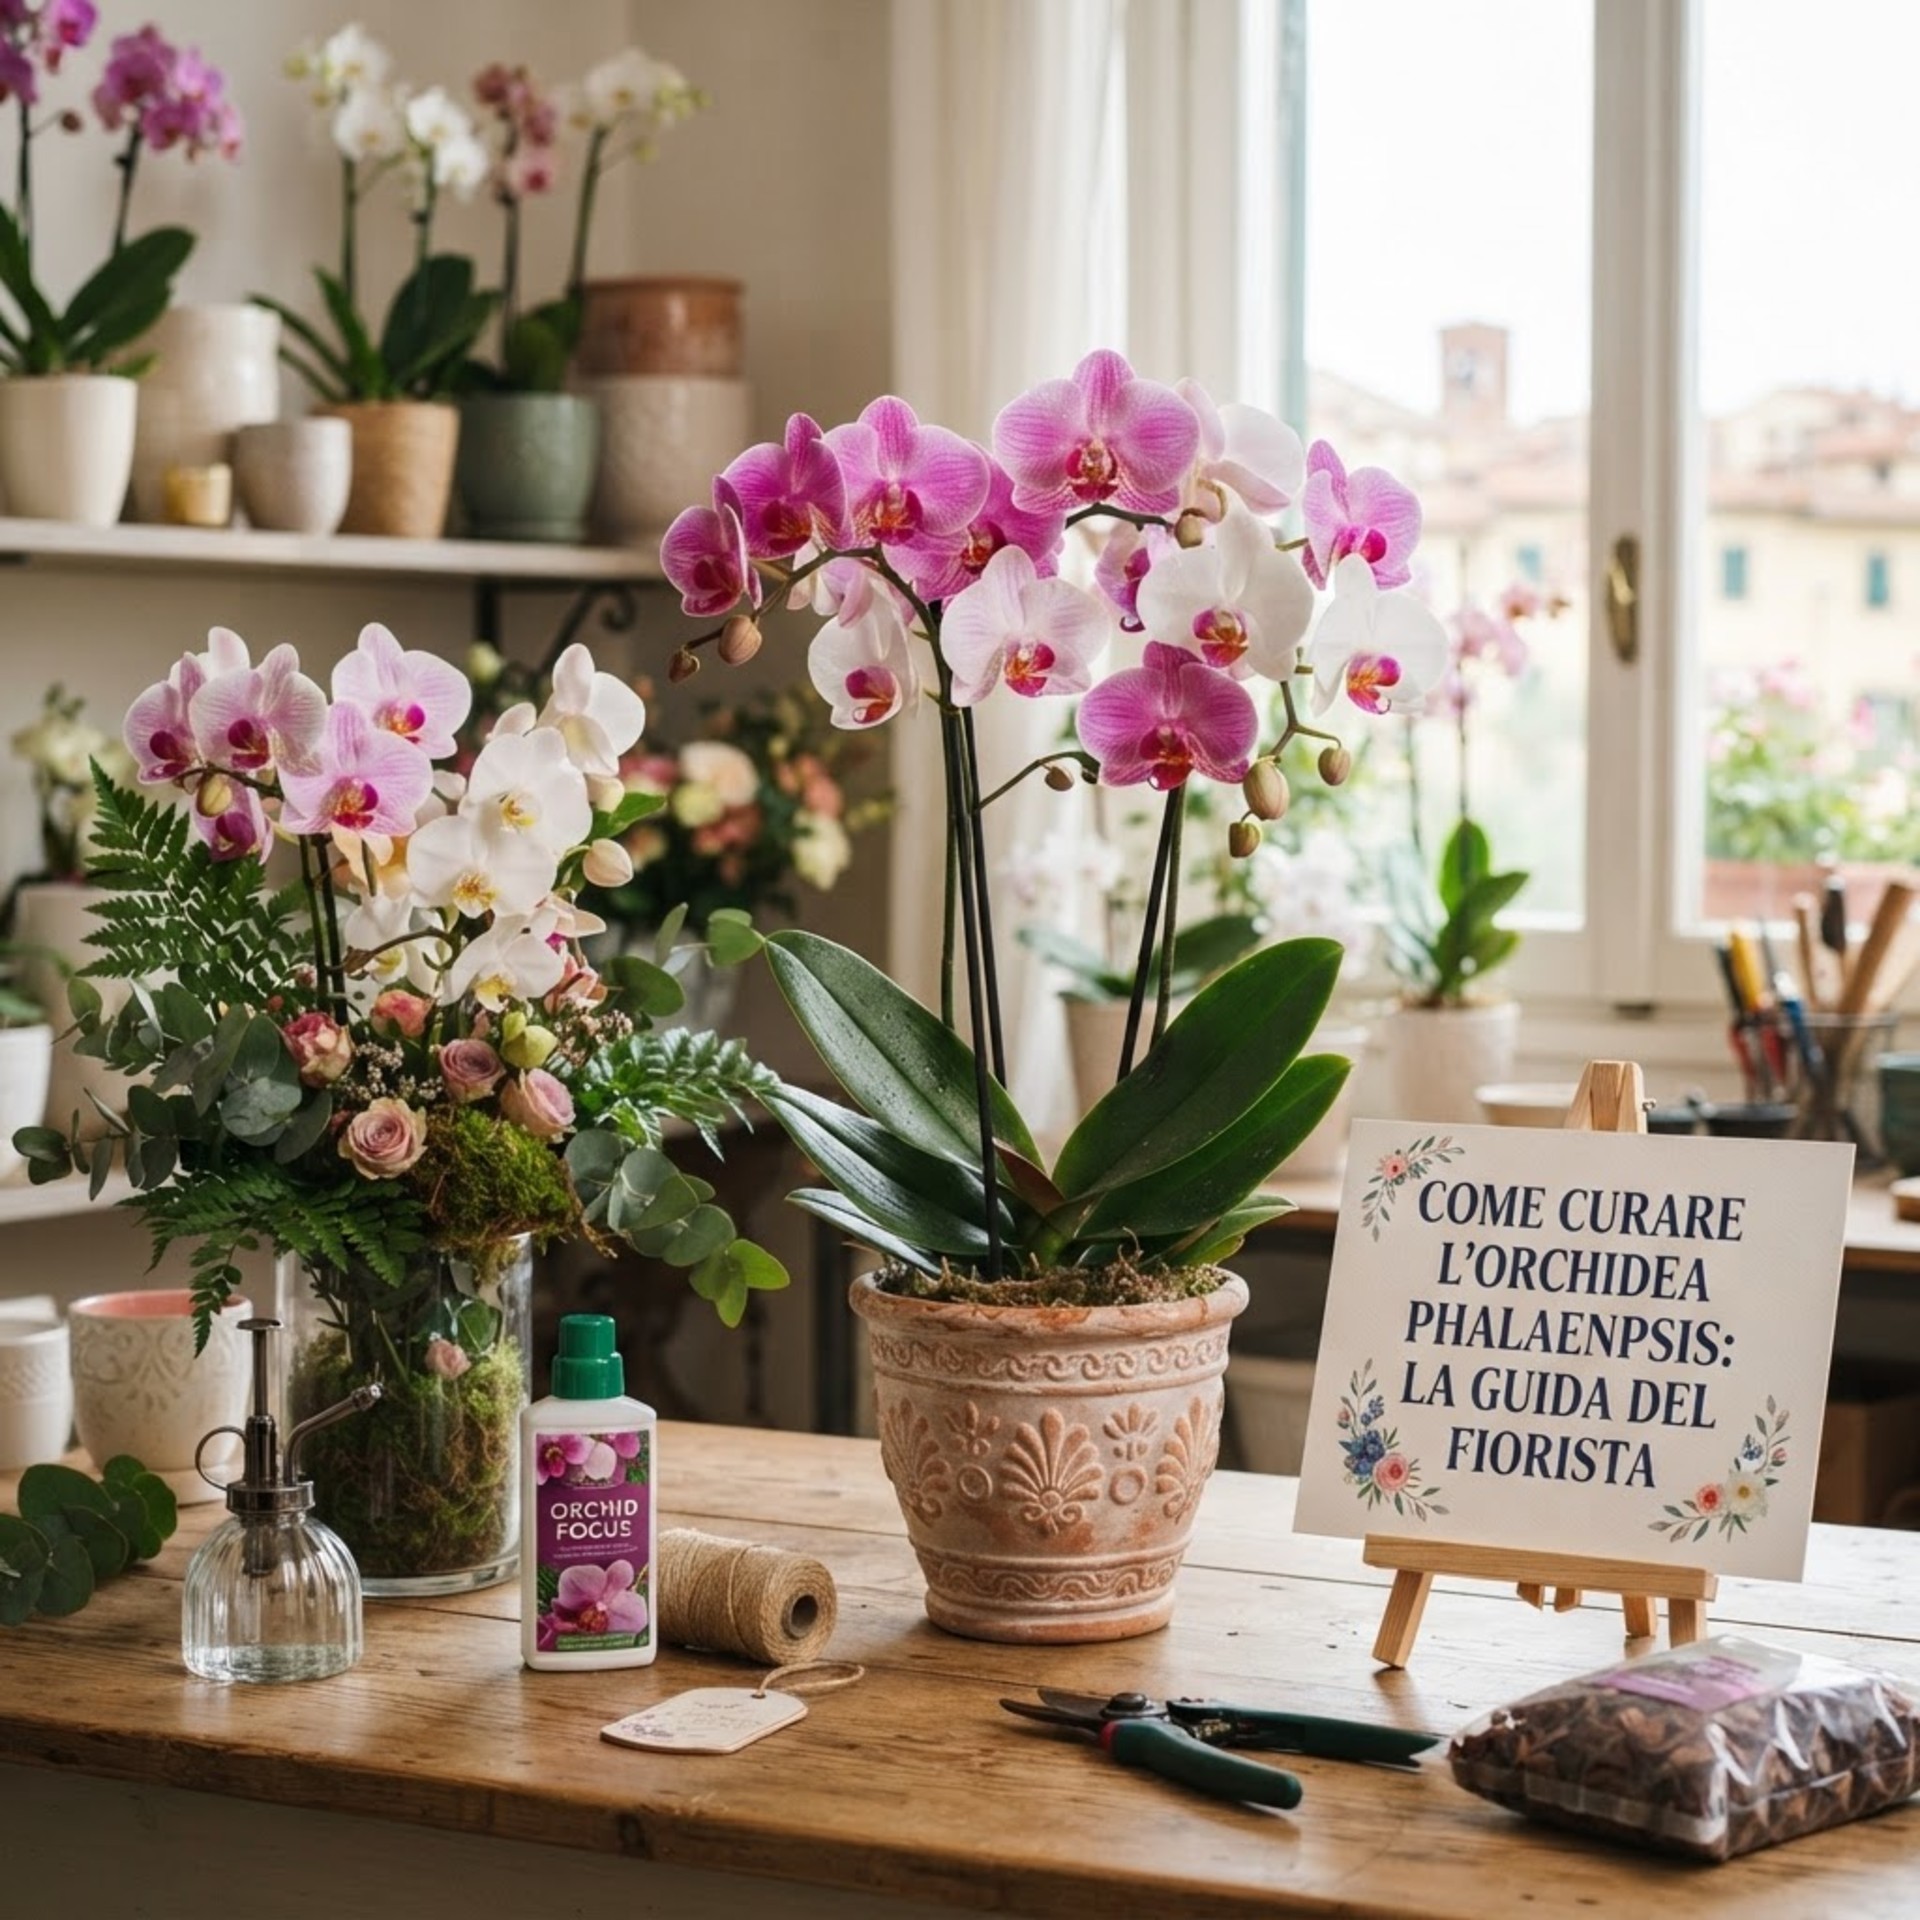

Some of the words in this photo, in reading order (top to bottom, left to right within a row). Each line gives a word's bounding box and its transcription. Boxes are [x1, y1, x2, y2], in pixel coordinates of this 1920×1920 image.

[1418, 1180, 1546, 1229] COME
[1558, 1188, 1746, 1242] CURARE
[1437, 1242, 1710, 1302] L’ORCHIDEA
[1404, 1301, 1735, 1368] PHALAENPSIS:
[1400, 1362, 1456, 1407] LA
[1471, 1366, 1611, 1421] GUIDA
[1627, 1379, 1717, 1428] DEL
[1446, 1427, 1656, 1488] FIORISTA
[550, 1499, 638, 1520] ORCHID
[556, 1520, 632, 1540] FOCUS
